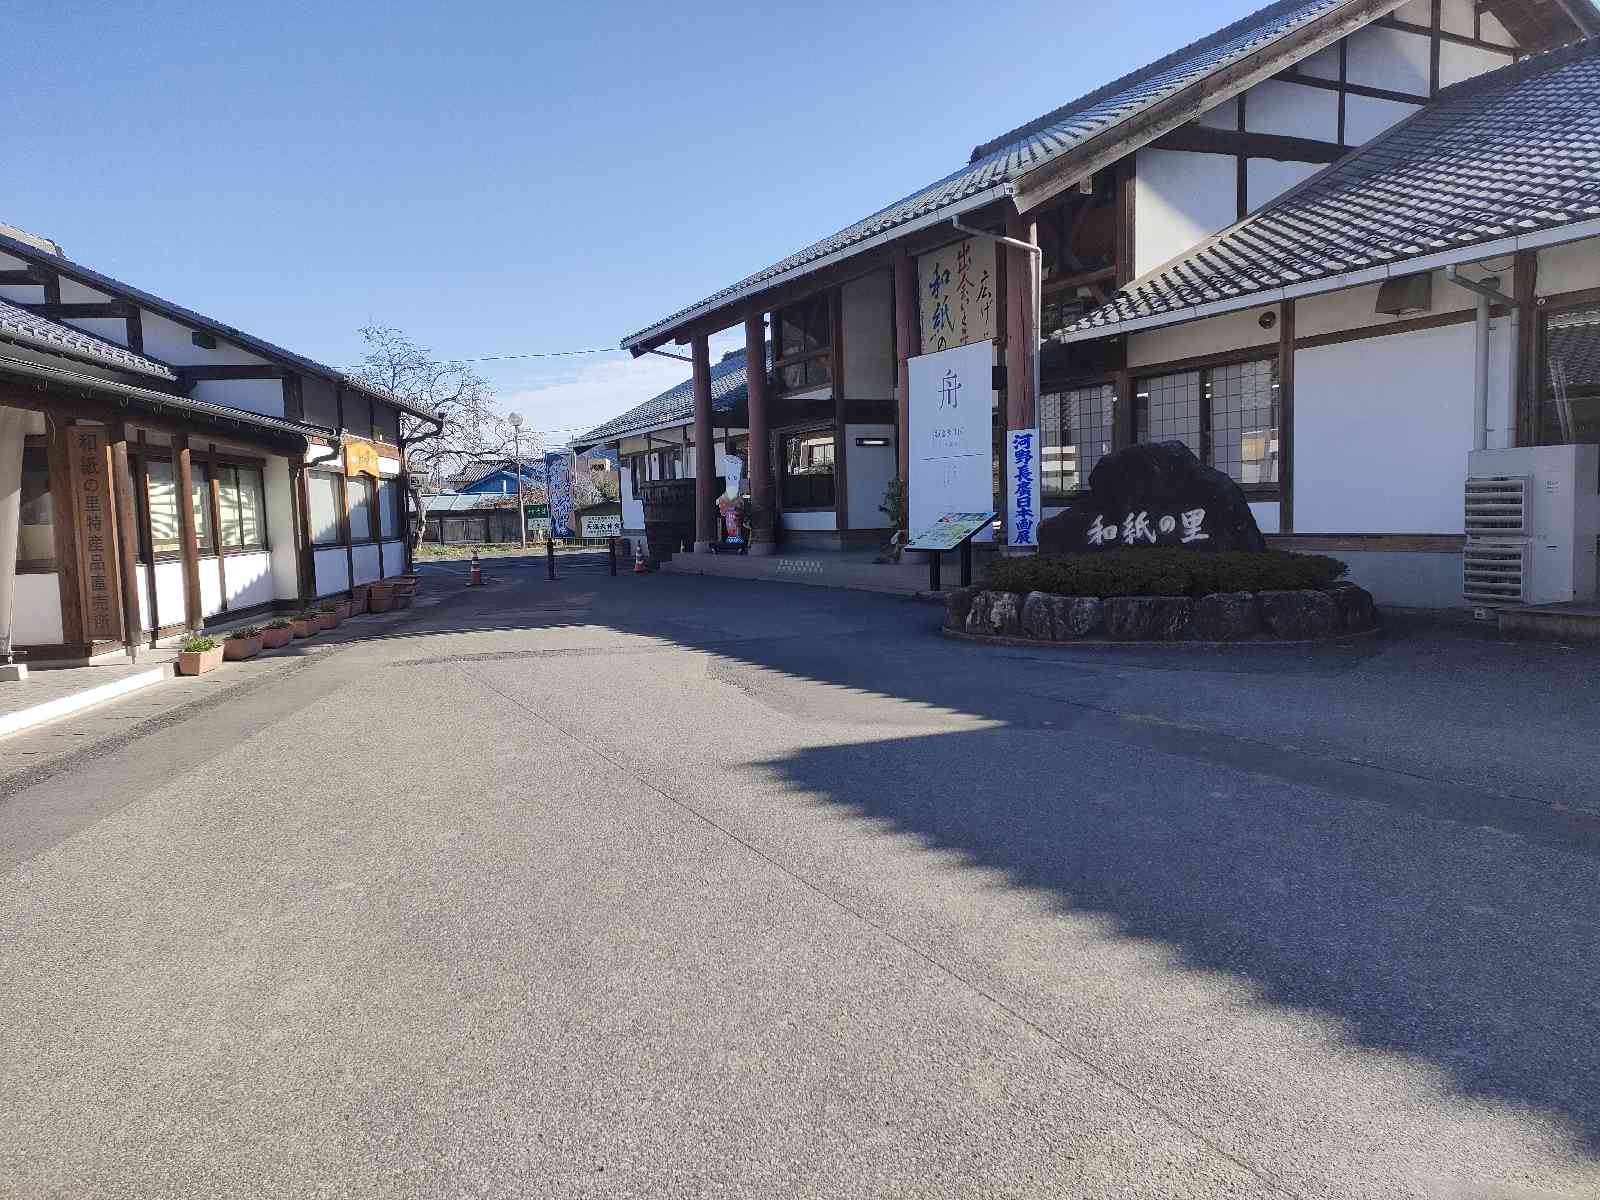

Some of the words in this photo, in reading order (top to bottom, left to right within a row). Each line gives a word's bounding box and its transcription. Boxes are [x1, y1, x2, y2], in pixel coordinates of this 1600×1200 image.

[937, 369, 962, 409] 舟
[1087, 508, 1210, 546] 和紙の里
